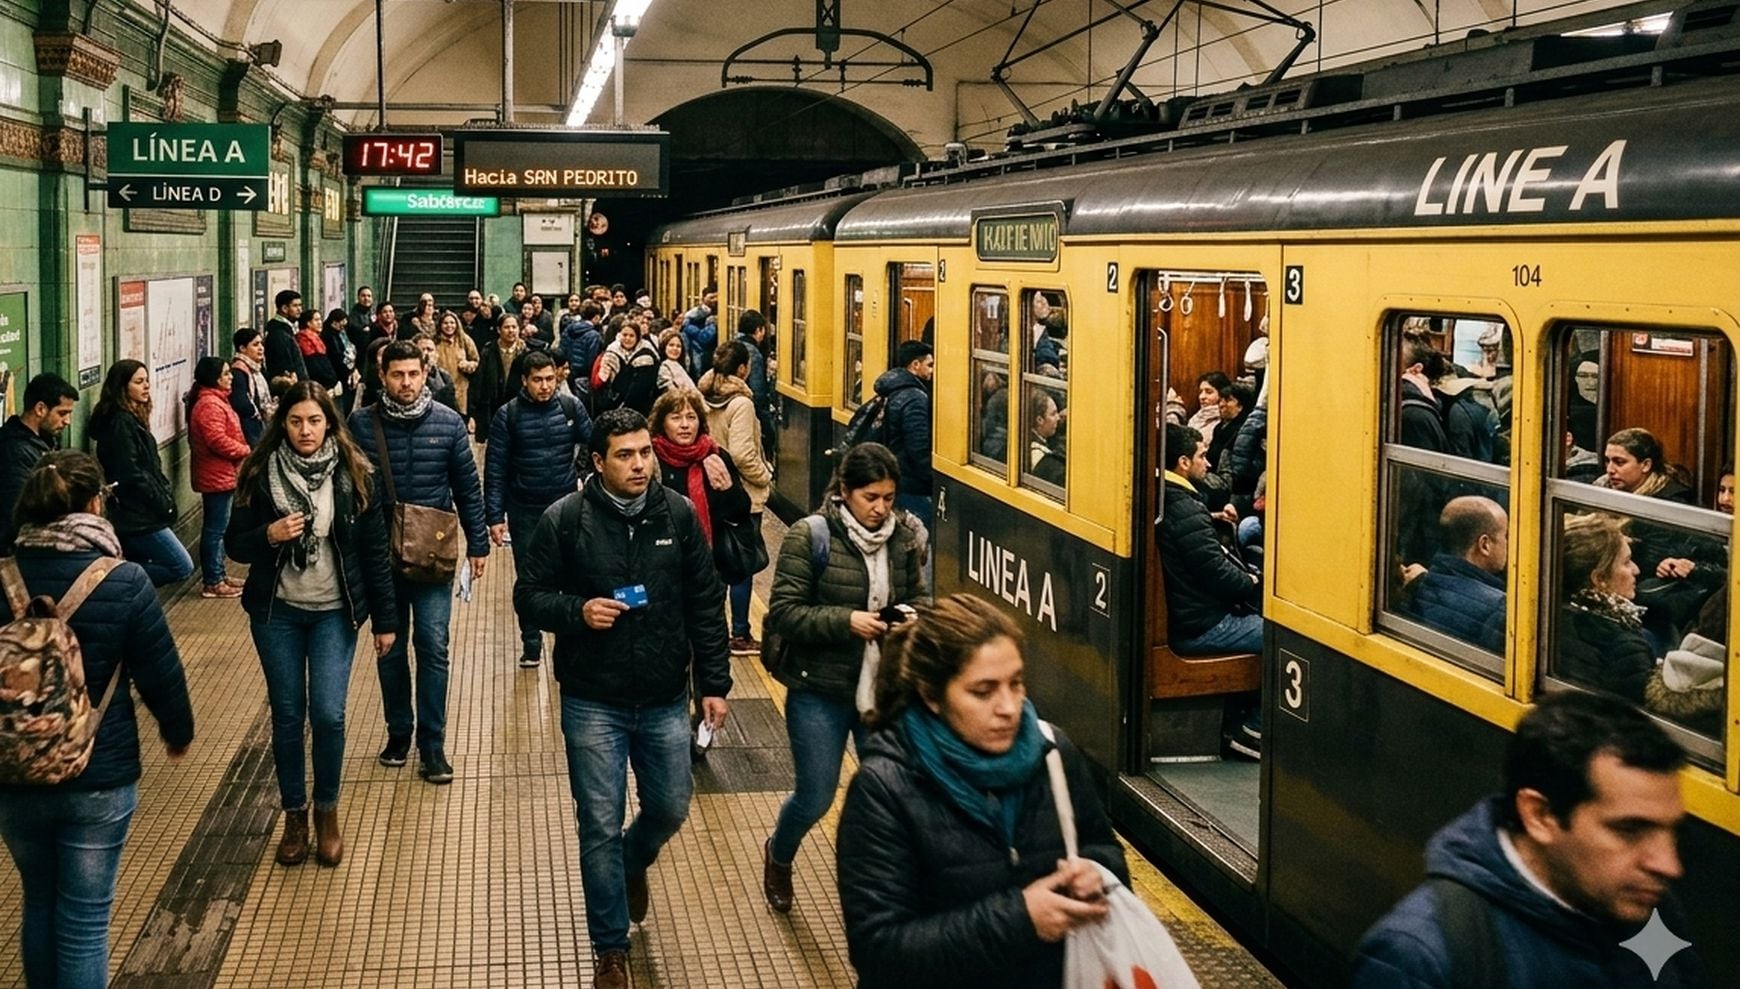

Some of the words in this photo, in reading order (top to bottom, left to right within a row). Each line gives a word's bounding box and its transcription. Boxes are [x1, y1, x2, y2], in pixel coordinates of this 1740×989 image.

[132, 132, 218, 162] LÍNEA
[223, 139, 246, 163] A
[361, 142, 434, 168] 17:42
[463, 168, 517, 185] Hacia
[563, 169, 638, 186] PEDRITO
[1413, 145, 1569, 216] LINE
[1568, 139, 1628, 211] A
[209, 187, 222, 202] D
[1108, 264, 1118, 291] 2
[1287, 268, 1300, 301] 3
[1511, 264, 1542, 287] 104
[968, 530, 1032, 616] LINEA
[1036, 571, 1057, 632] A
[1094, 571, 1107, 610] 2
[1284, 660, 1303, 709] 3
